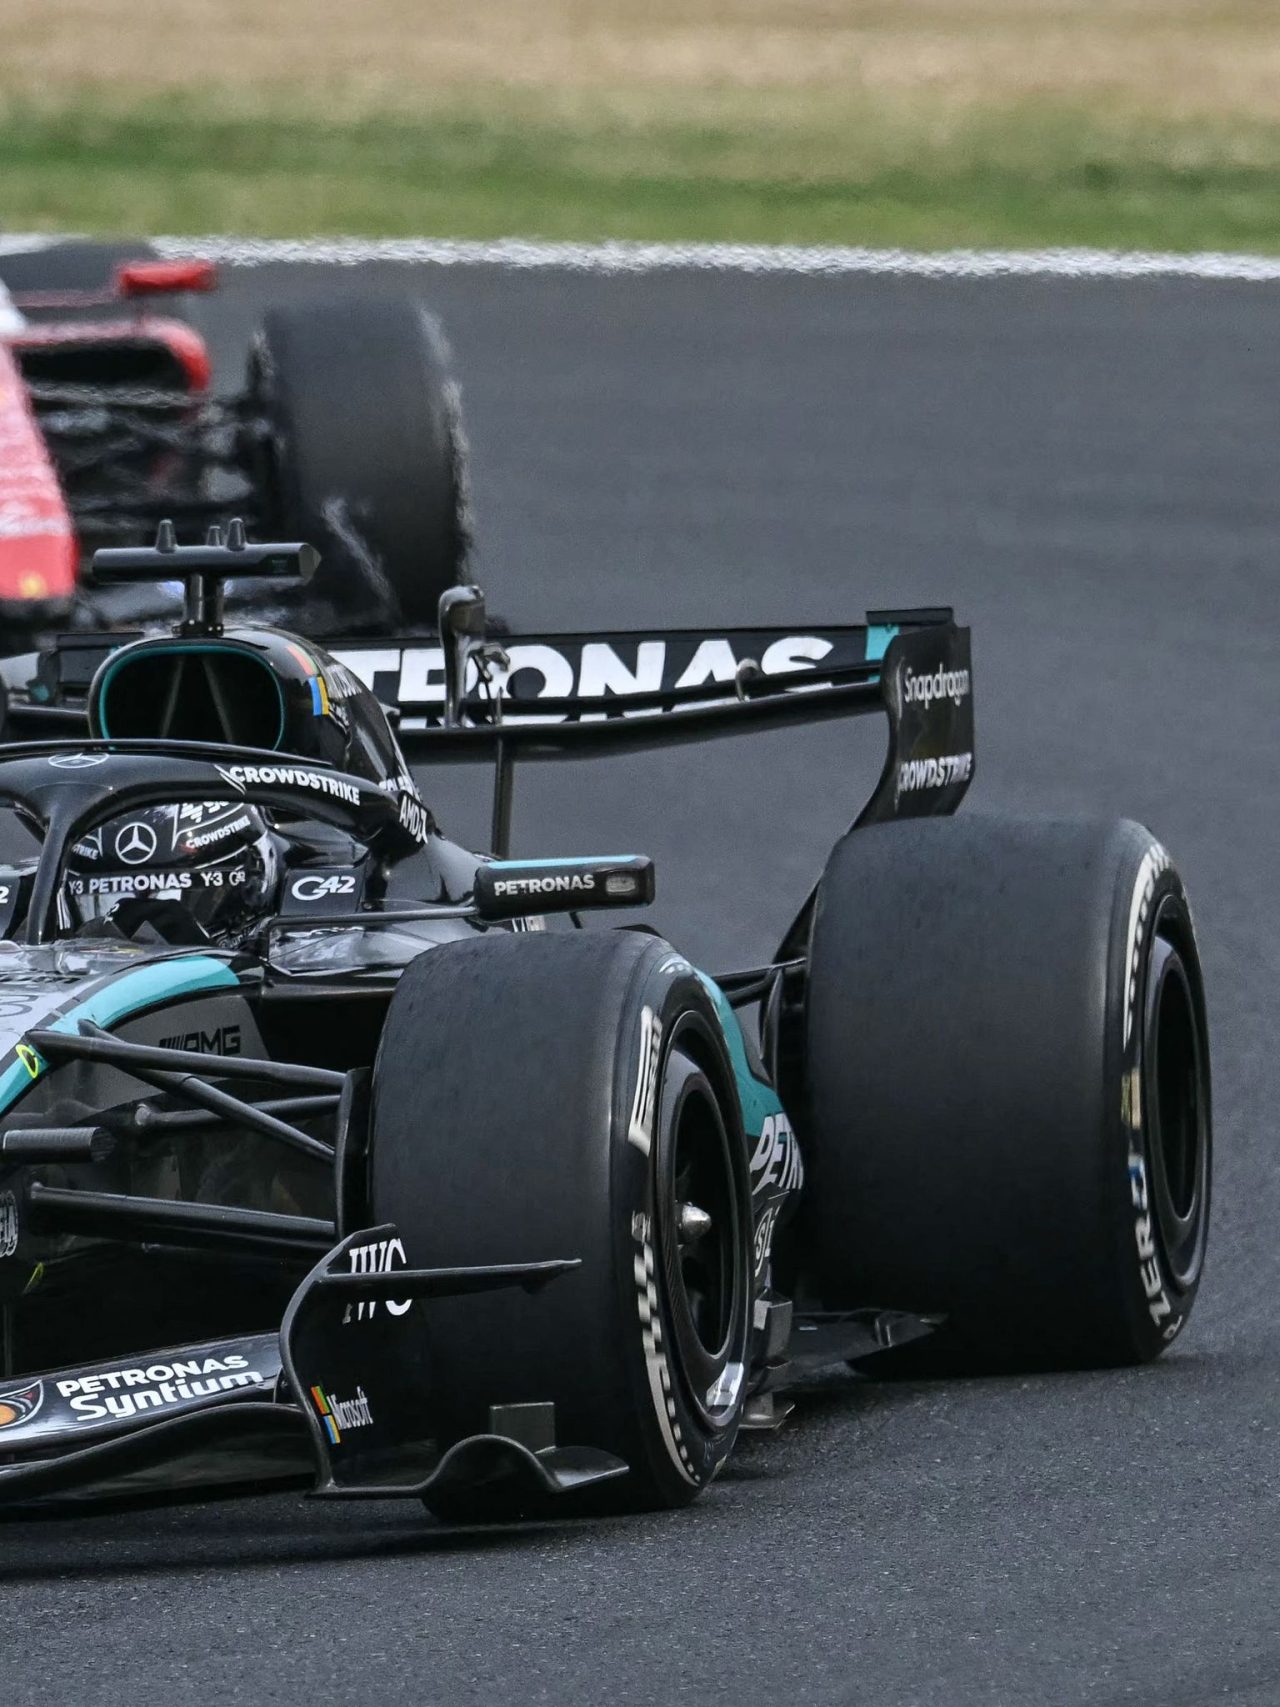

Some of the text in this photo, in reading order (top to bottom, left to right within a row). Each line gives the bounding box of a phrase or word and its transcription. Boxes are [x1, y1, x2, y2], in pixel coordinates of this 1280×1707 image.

[326, 636, 834, 730] TRONAS
[229, 766, 361, 806] CROWDSTRIKE
[185, 815, 251, 849] CROWDSTRIKE
[89, 872, 192, 892] PETRONAS
[201, 871, 223, 887] Y-3
[291, 875, 356, 901] G42
[494, 873, 595, 897] PETRONAS
[183, 1024, 240, 1056] AMG
[56, 1355, 249, 1398] PETRONAS
[69, 1371, 265, 1422] Syntium
[325, 1385, 375, 1431] Microsoft
